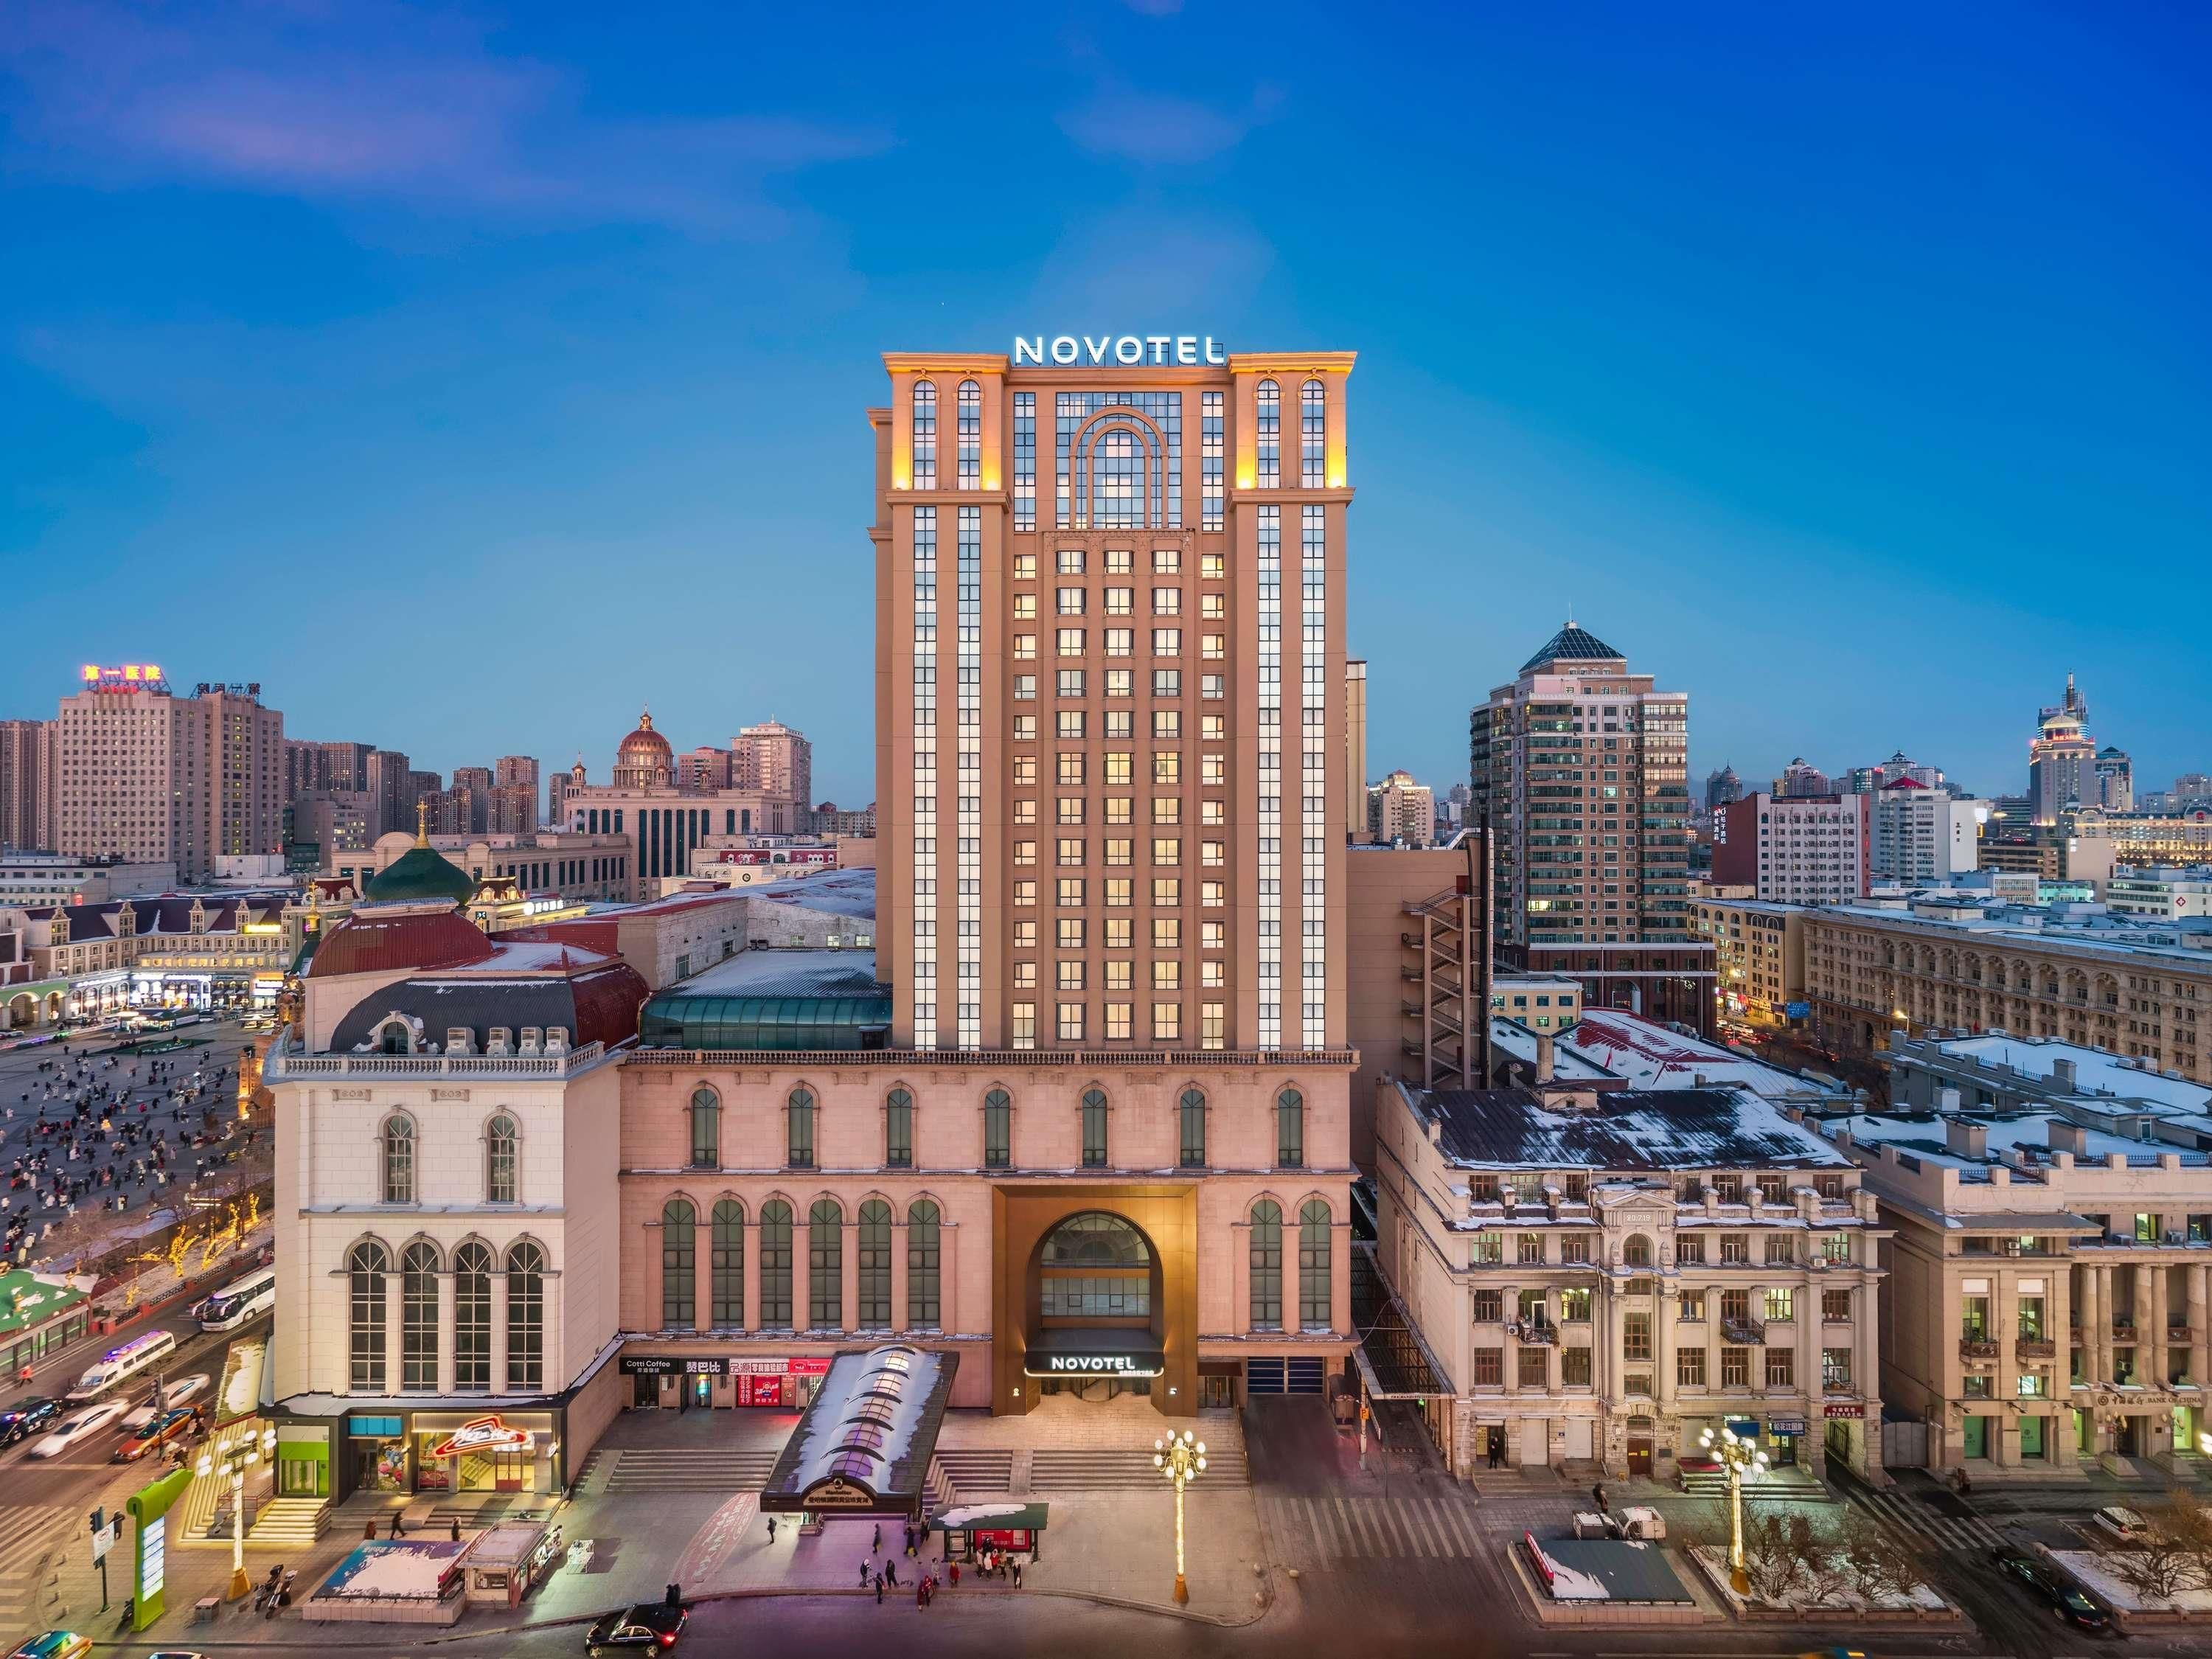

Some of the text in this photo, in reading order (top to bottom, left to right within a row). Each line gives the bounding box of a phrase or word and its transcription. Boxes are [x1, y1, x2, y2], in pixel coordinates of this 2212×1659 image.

[1015, 335, 1224, 365] NOVOTEL
[83, 664, 161, 681] 第一医院
[1051, 1357, 1135, 1370] NOVOTEL
